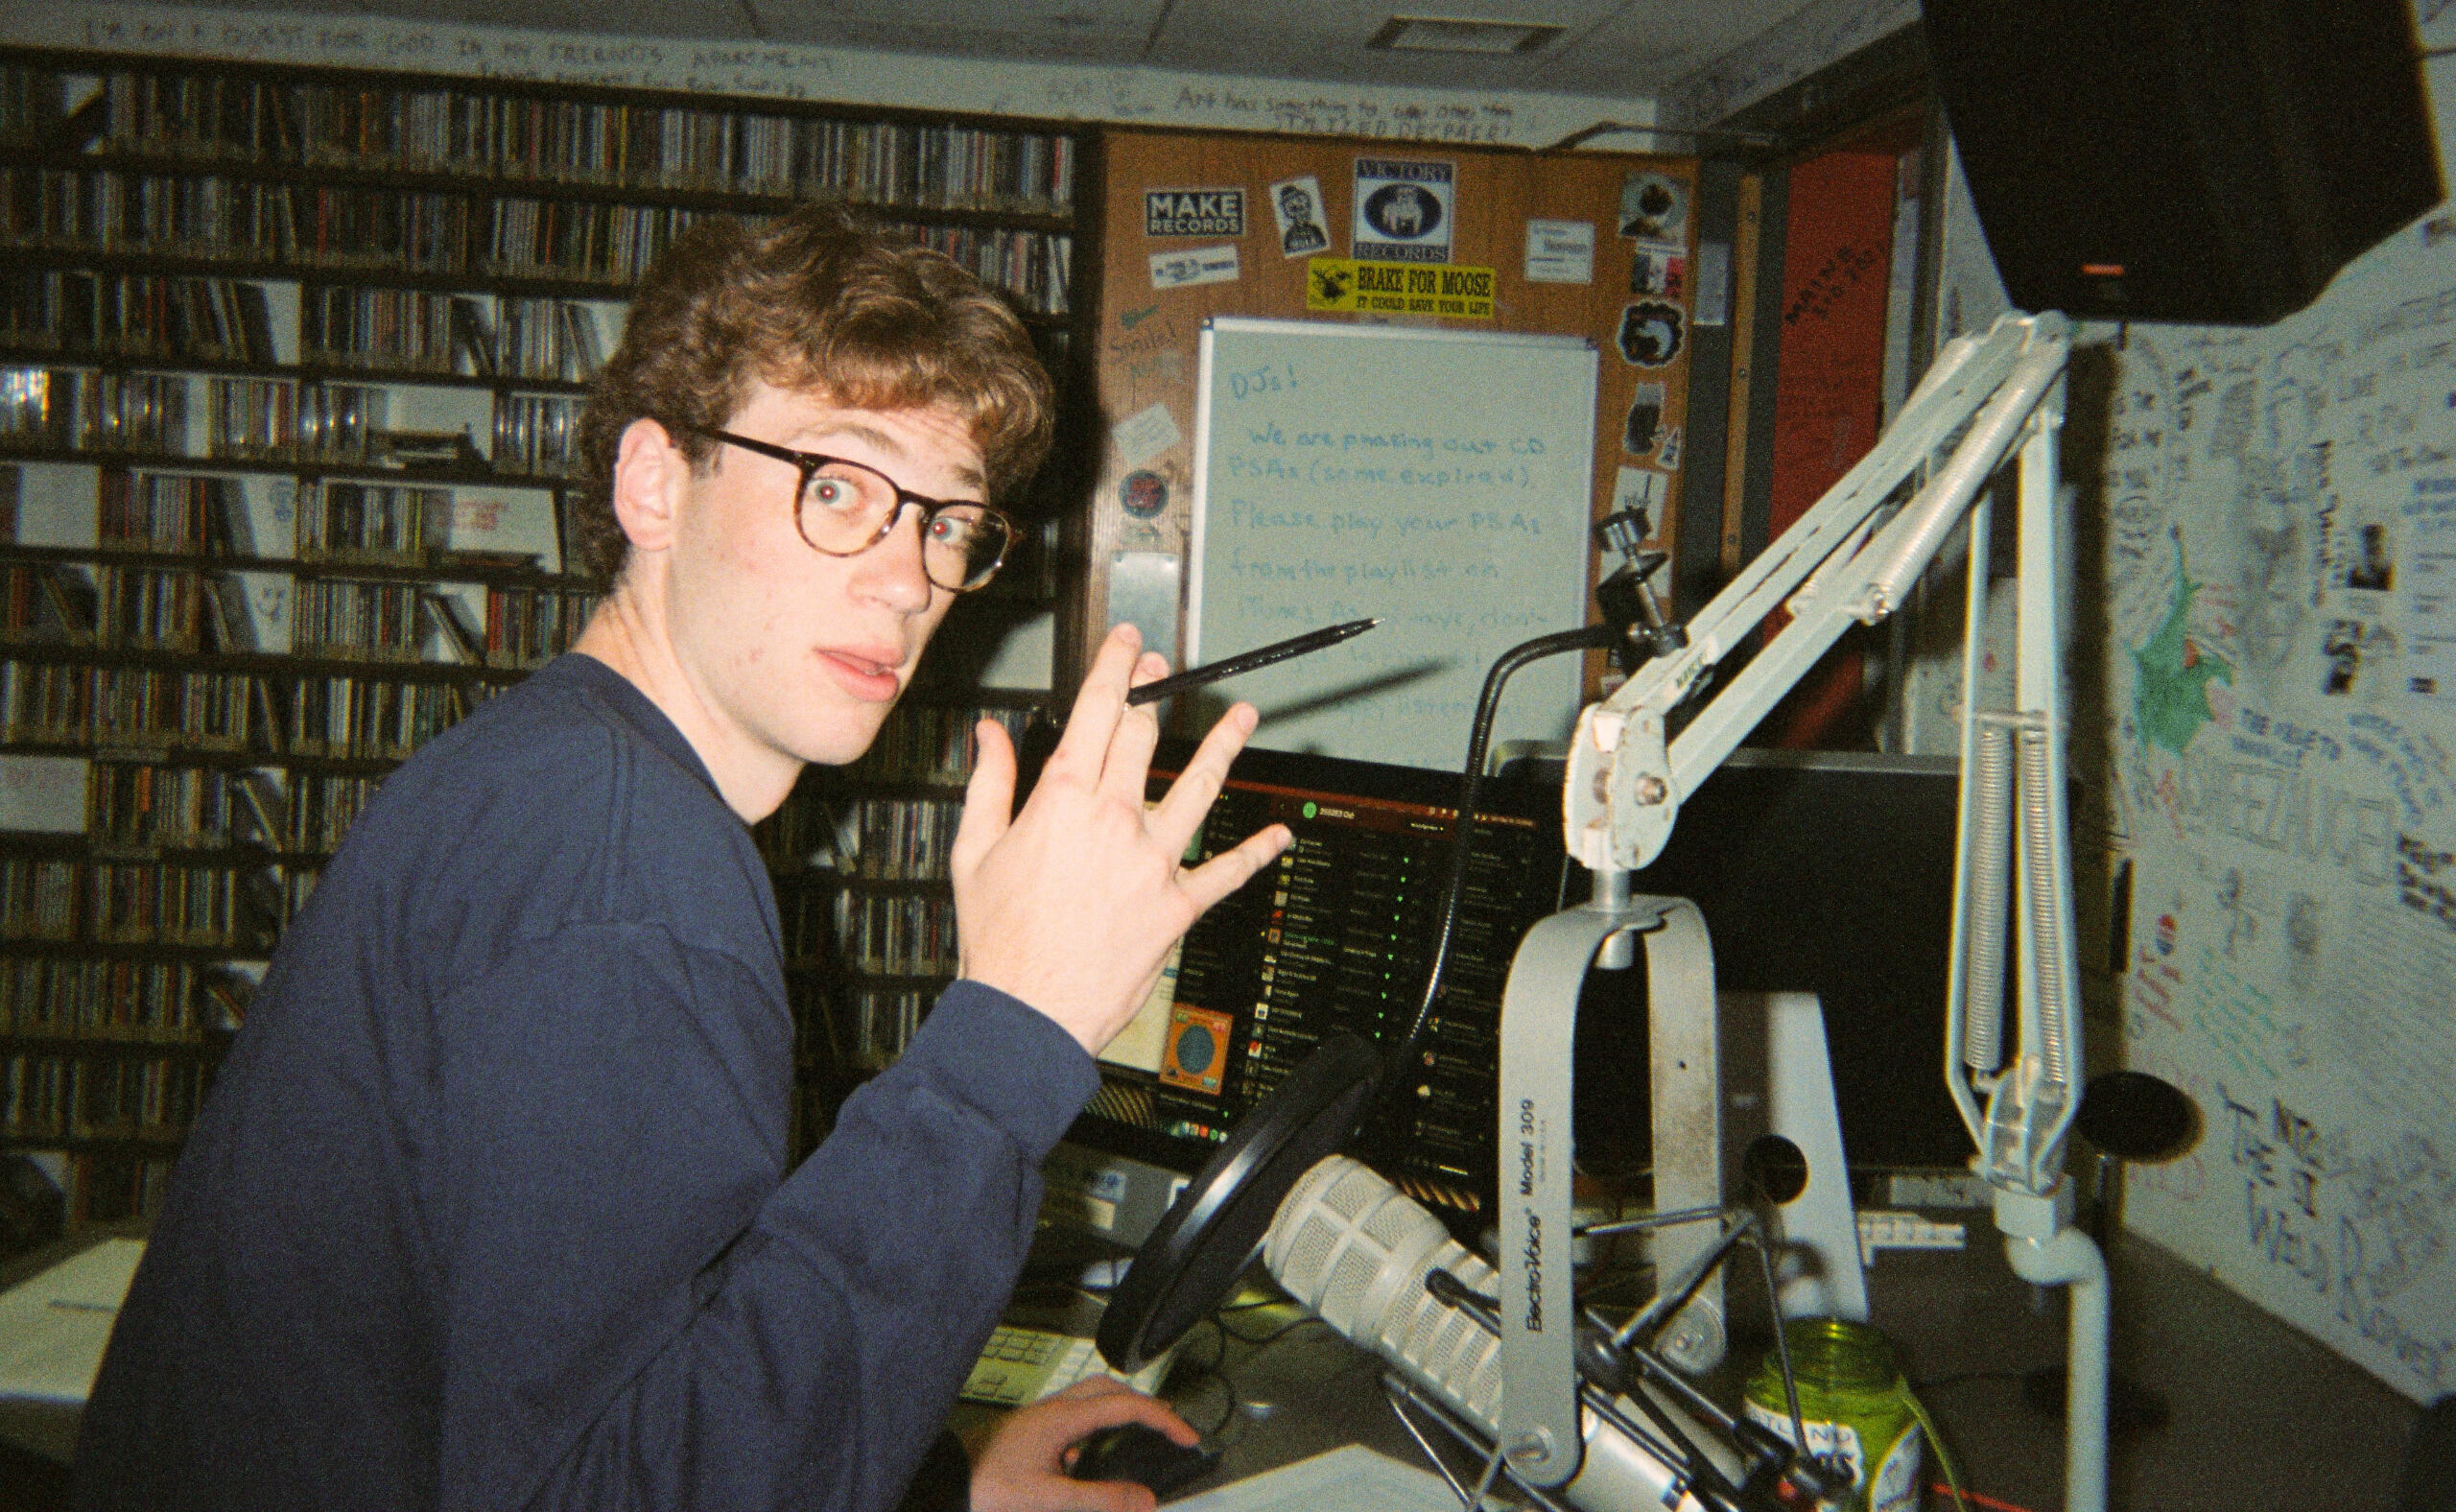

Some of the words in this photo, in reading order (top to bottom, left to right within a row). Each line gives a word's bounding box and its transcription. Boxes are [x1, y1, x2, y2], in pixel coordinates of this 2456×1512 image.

[1358, 159, 1452, 182] VICTORY
[1151, 194, 1238, 218] MAKE
[1151, 218, 1240, 233] RECORDS
[1356, 244, 1448, 262] RECORDS
[1358, 267, 1404, 292] BRAKE
[1408, 270, 1436, 294] FOR
[1442, 271, 1491, 297] MOOSE
[1357, 295, 1367, 308] IT
[1371, 296, 1405, 310] COULD
[1408, 298, 1434, 313] SAVE
[1438, 300, 1464, 314] YOUR
[1469, 302, 1491, 317] LIFE
[1230, 365, 1299, 402] DJs!
[1250, 420, 1287, 447] We
[1297, 431, 1335, 448] are
[1343, 430, 1435, 461] phasing
[1442, 436, 1499, 455] out
[1509, 437, 1547, 457] CD
[1232, 498, 1320, 529] Please
[1331, 508, 1382, 538] play
[1395, 513, 1458, 536] your
[1521, 1099, 1536, 1136] 309
[1519, 1142, 1535, 1196] Model
